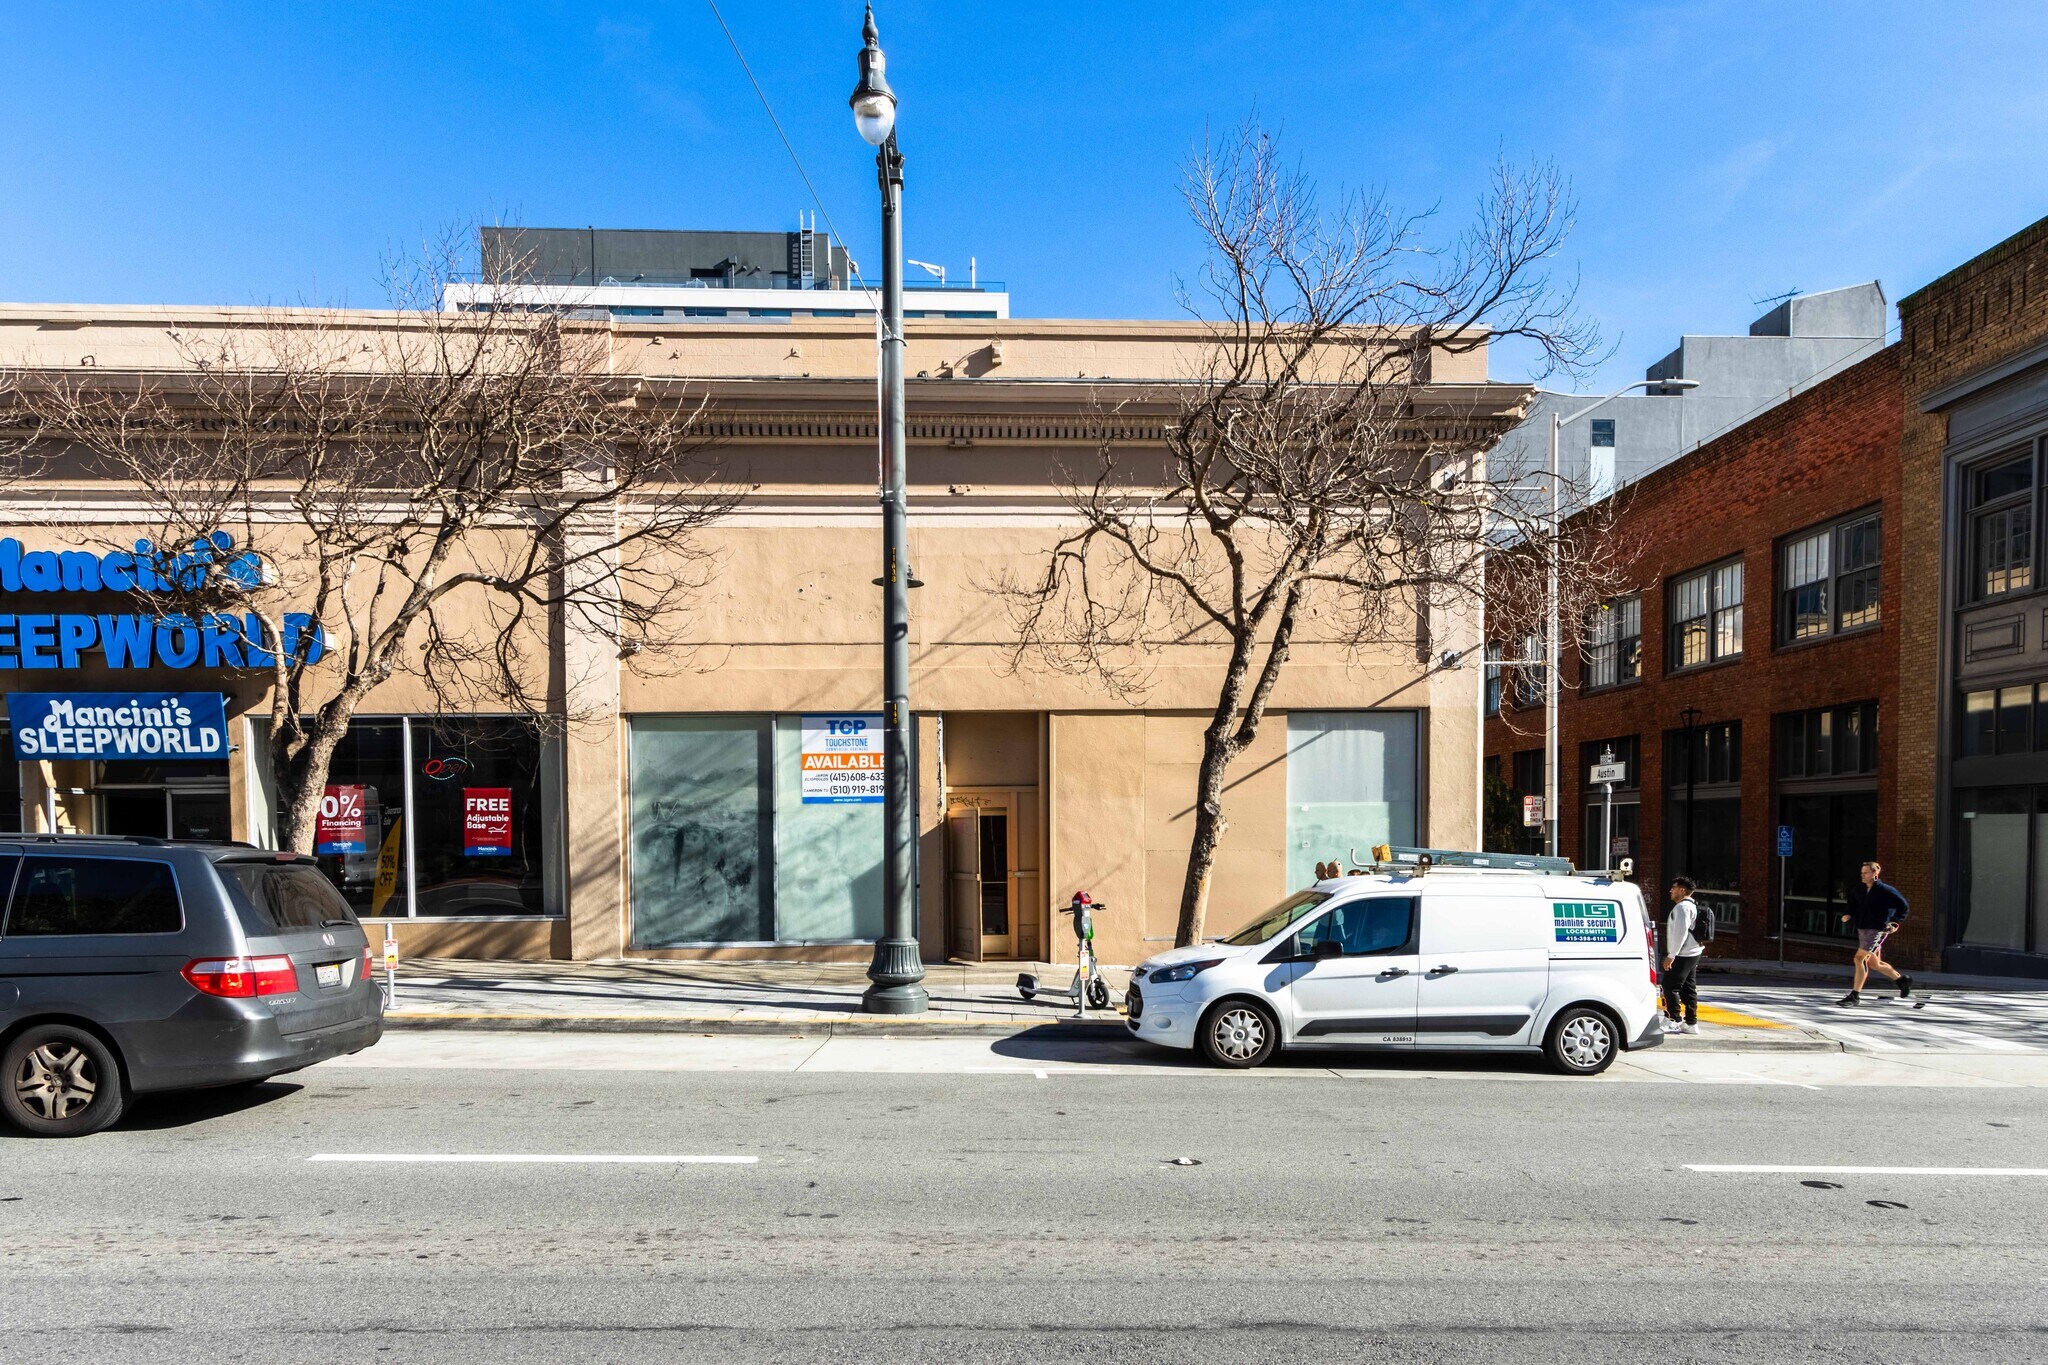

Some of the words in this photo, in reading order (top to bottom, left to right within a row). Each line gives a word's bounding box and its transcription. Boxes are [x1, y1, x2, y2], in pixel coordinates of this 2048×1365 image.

[43, 697, 192, 732] Mancini's
[826, 720, 867, 735] TCP
[19, 727, 220, 754] SLEEPWORLD
[825, 738, 868, 747] TOUCHSTONE
[1597, 767, 1616, 779] Austin
[320, 794, 361, 818] 0%
[466, 798, 509, 811] FREE
[321, 819, 361, 828] Financing
[466, 814, 509, 823] Adjustable
[466, 821, 487, 829] Base
[380, 855, 396, 869] 50%
[380, 871, 394, 886] OFF
[1555, 919, 1585, 927] mainline
[1586, 919, 1616, 928] security
